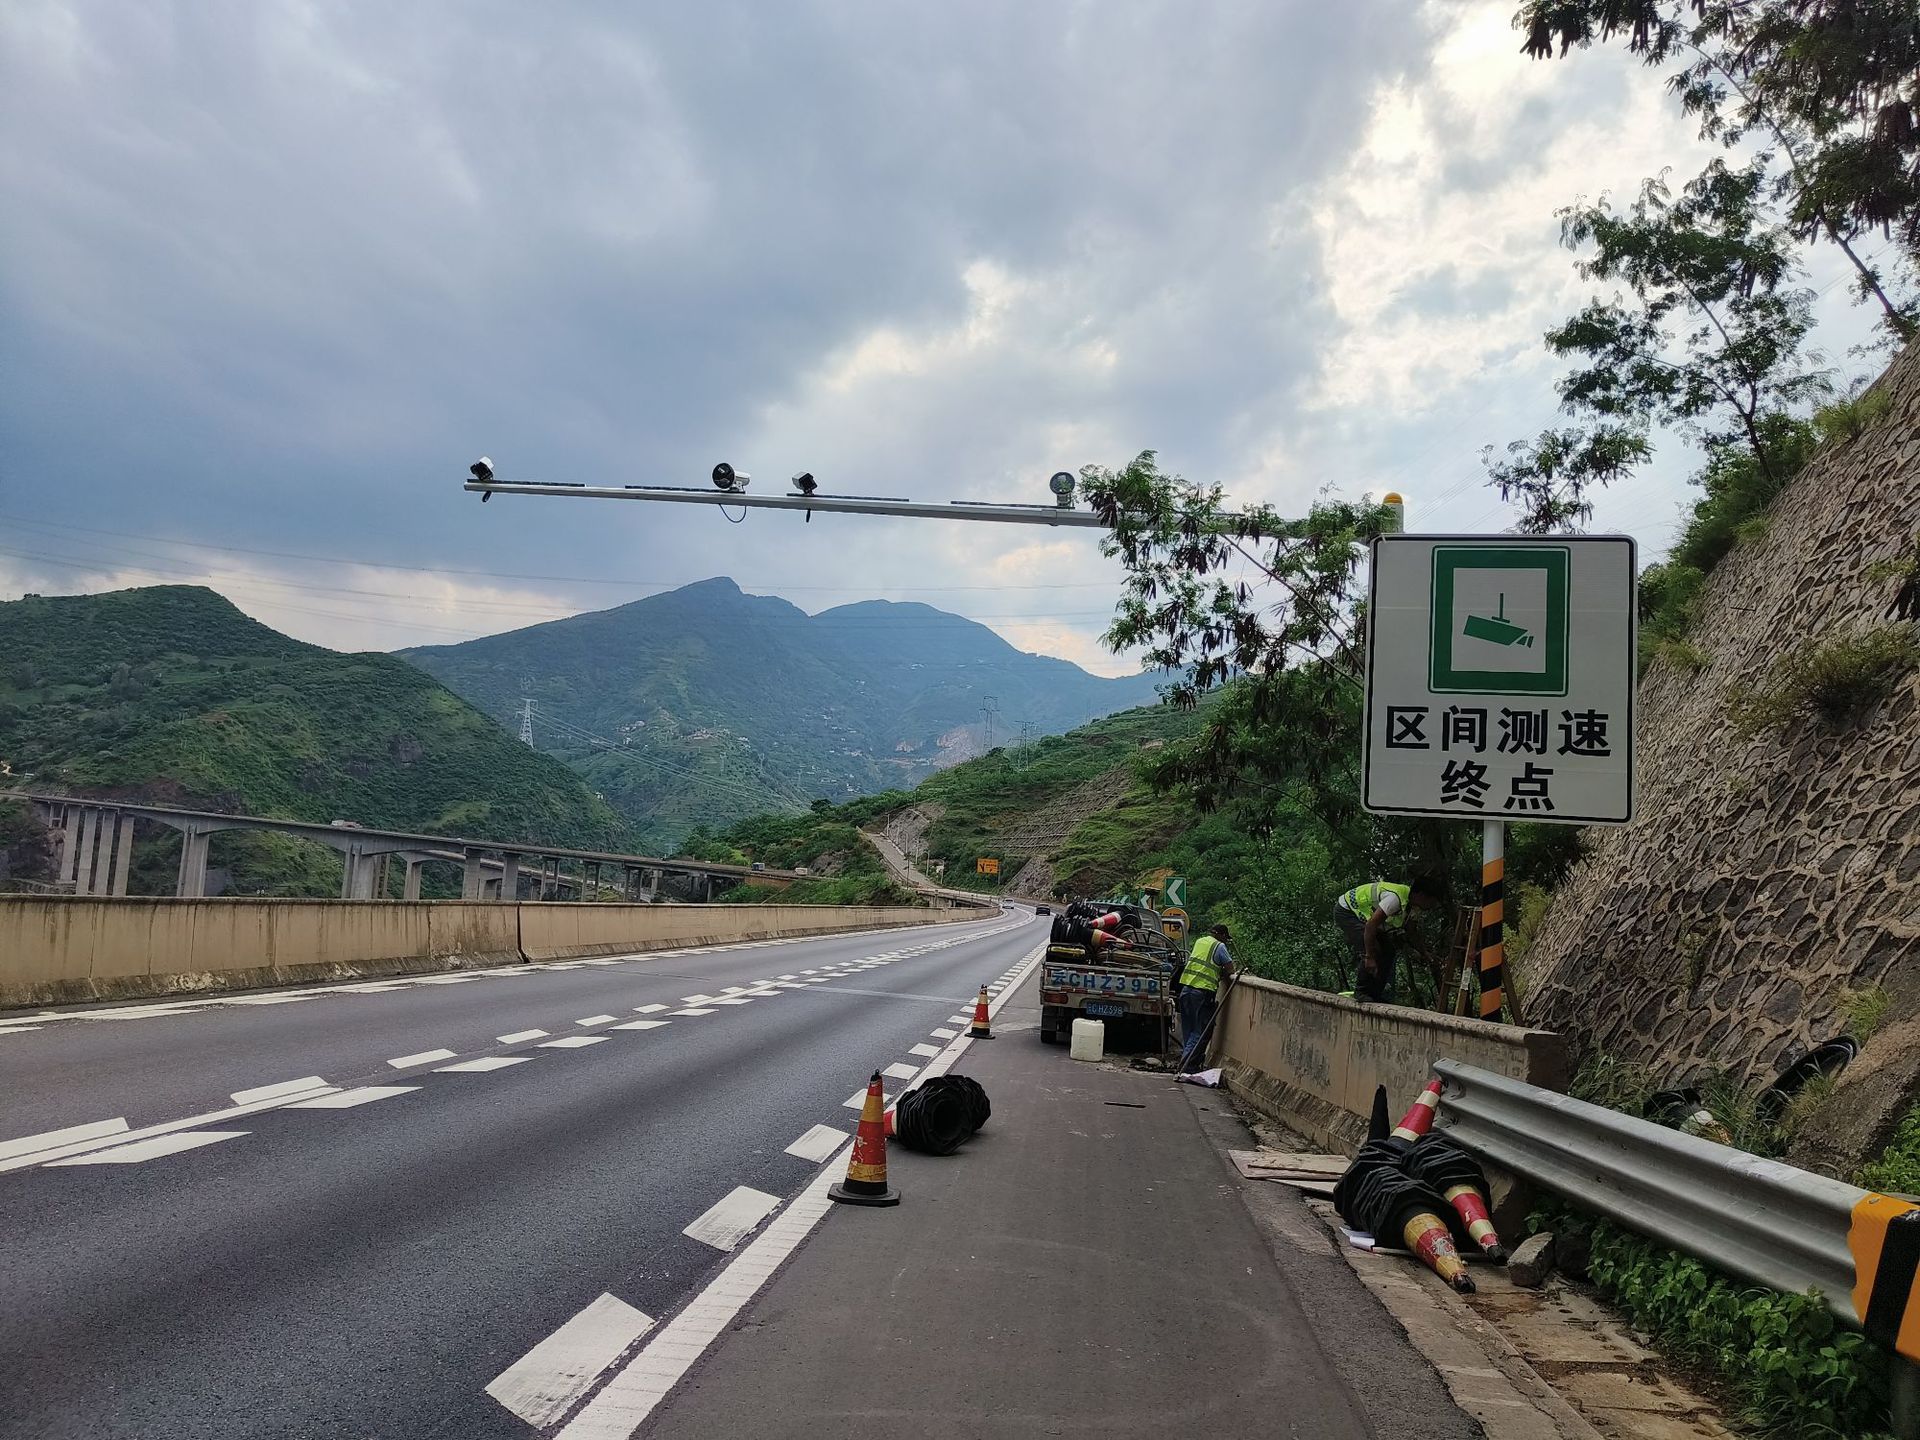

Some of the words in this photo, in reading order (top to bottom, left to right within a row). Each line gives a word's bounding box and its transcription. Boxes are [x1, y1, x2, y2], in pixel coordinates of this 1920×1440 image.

[1386, 705, 1611, 756] 区间测速
[1440, 760, 1555, 811] 终点
